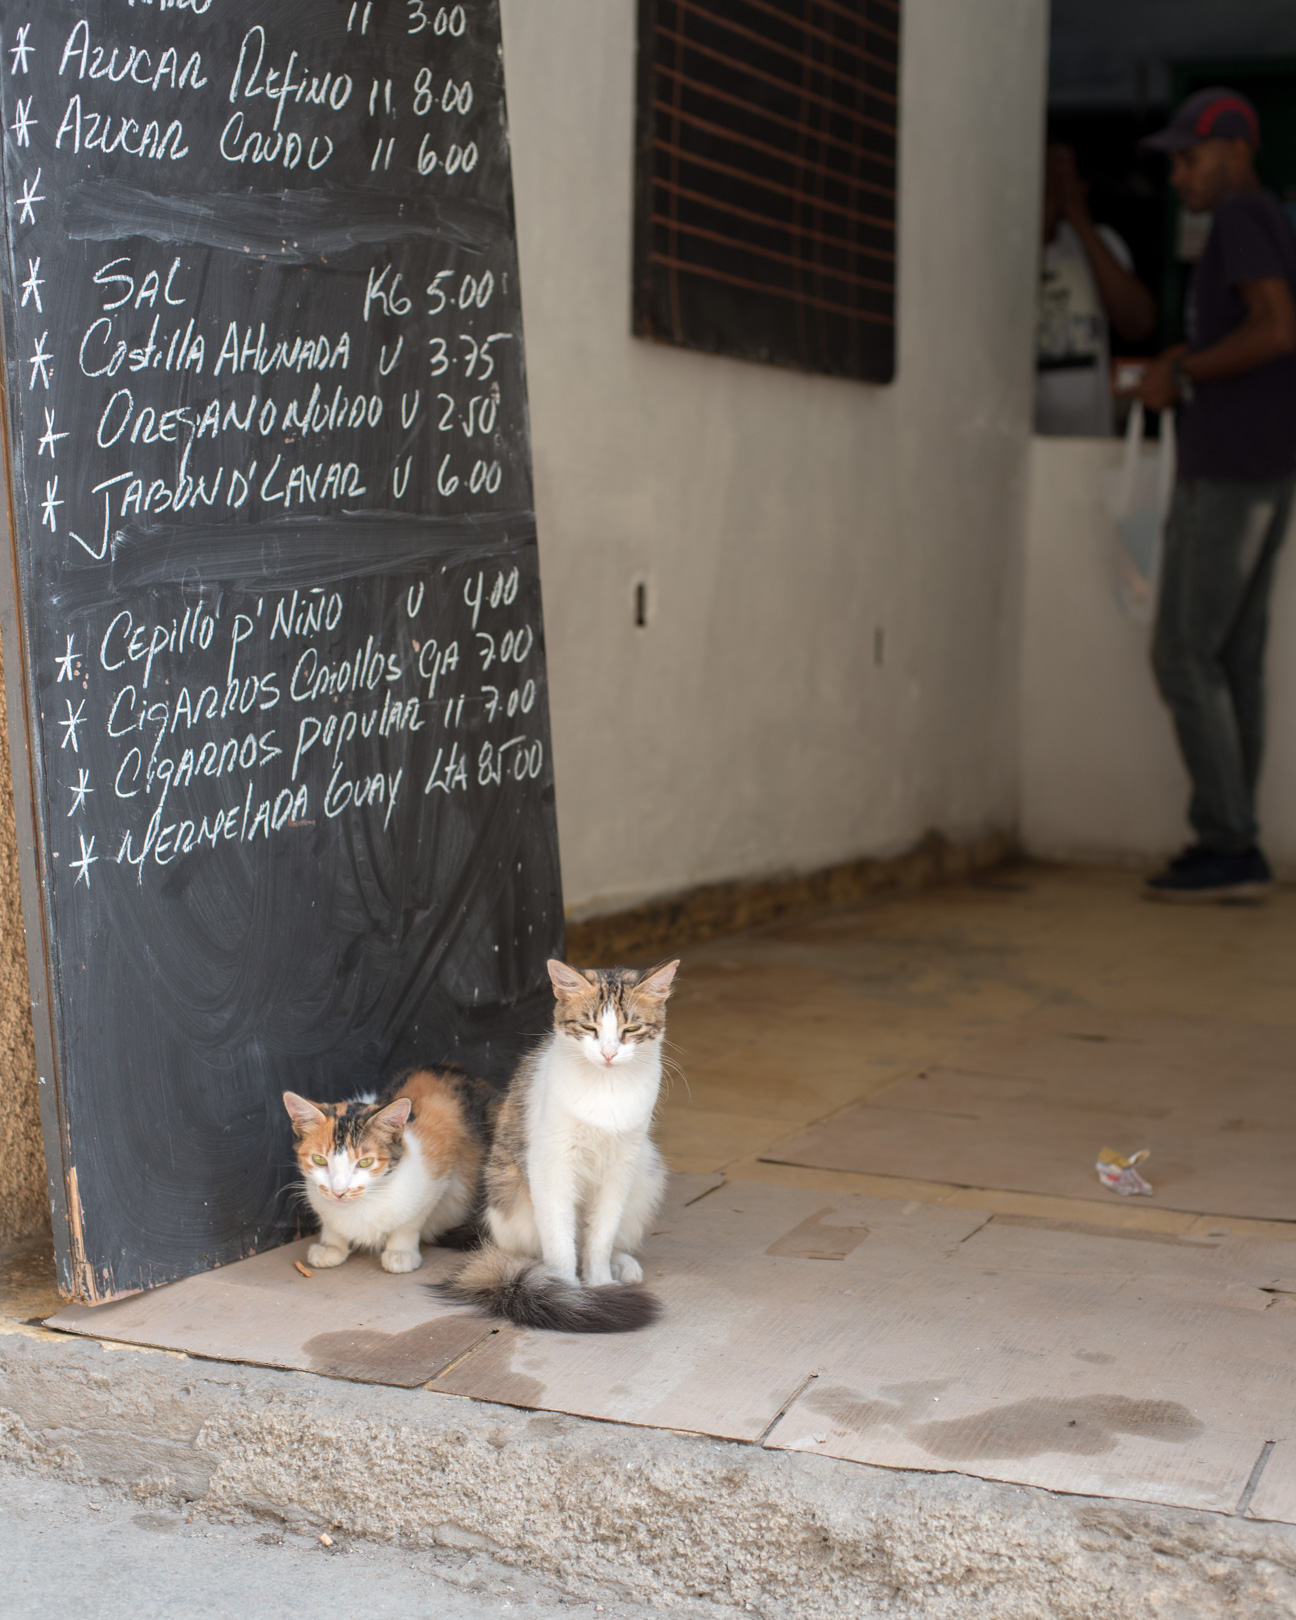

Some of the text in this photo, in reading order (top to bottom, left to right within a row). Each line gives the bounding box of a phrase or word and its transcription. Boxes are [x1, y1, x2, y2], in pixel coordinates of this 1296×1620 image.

[408, 0, 466, 36] 3.00
[414, 67, 473, 116] 8.00
[418, 133, 478, 175] 6.00
[93, 257, 186, 310] SAL
[427, 270, 494, 315] 5.00
[379, 335, 403, 375] U
[429, 333, 512, 381] 3.75
[402, 390, 419, 429] U
[437, 393, 496, 437] 2.50
[393, 456, 413, 498] U
[438, 454, 501, 497] 6.00
[464, 566, 519, 631] 4.00
[476, 624, 533, 671] 7.00
[481, 679, 535, 723] 7.00
[478, 735, 543, 787] 85.00
